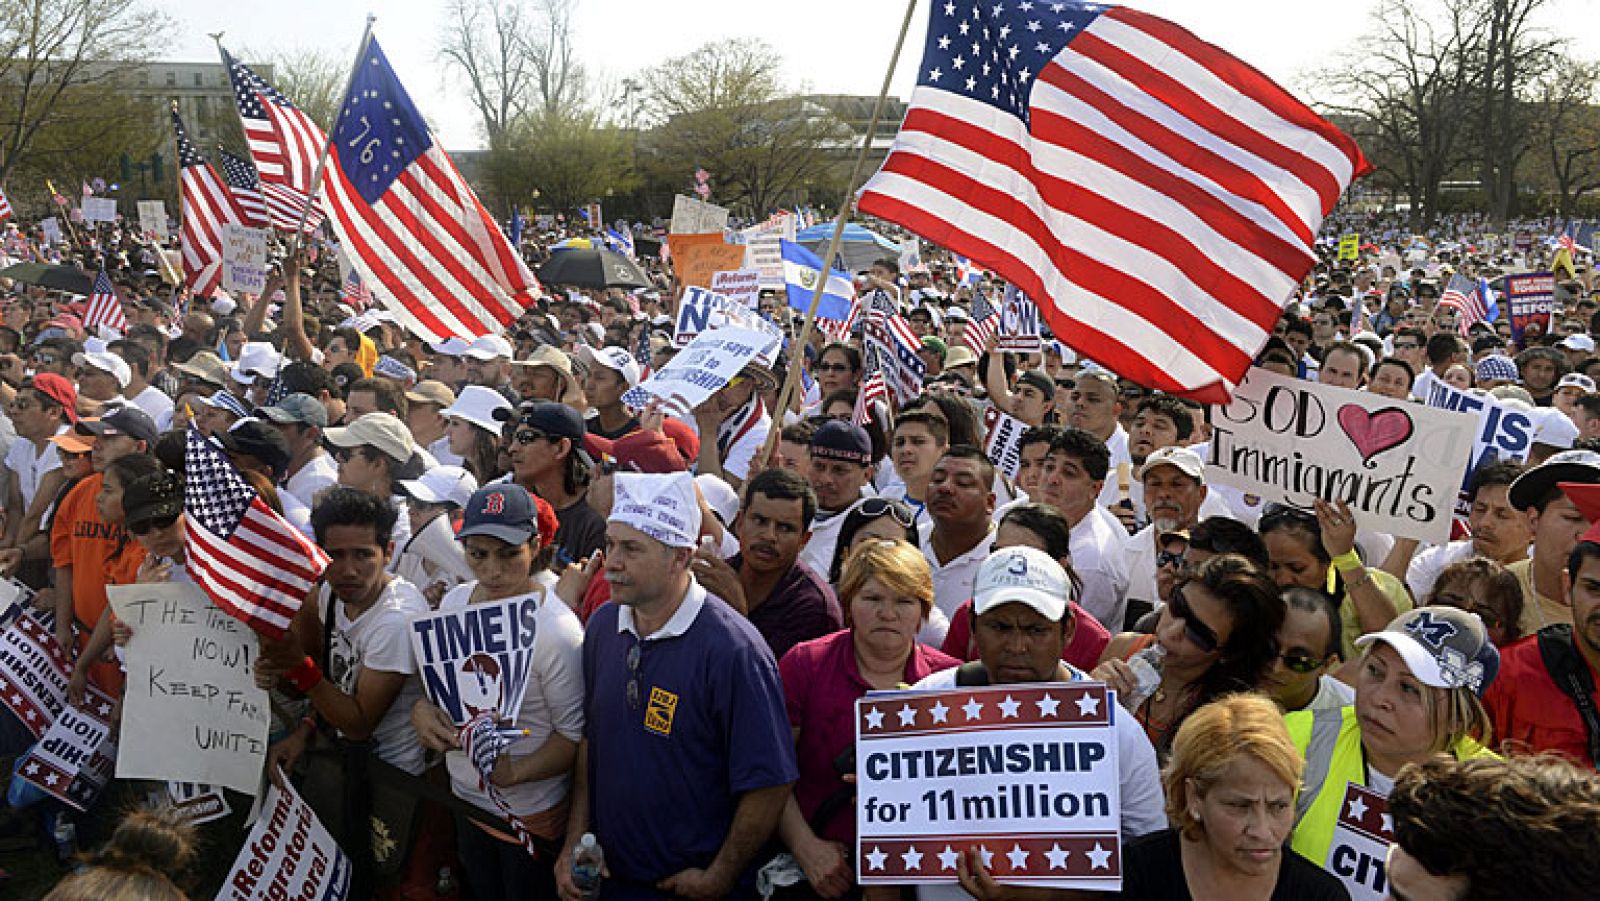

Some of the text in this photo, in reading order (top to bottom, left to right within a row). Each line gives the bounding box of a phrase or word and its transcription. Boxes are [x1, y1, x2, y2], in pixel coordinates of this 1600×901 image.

[1481, 406, 1532, 451] IS
[1207, 427, 1437, 522] Immigrants
[124, 599, 238, 633] THE TIME
[413, 598, 537, 663] TIME IS
[193, 637, 249, 675] NOW!
[150, 665, 219, 701] KEEP
[422, 648, 534, 722] NW
[865, 741, 1105, 781] CITIZENSHIP
[864, 797, 911, 823] for
